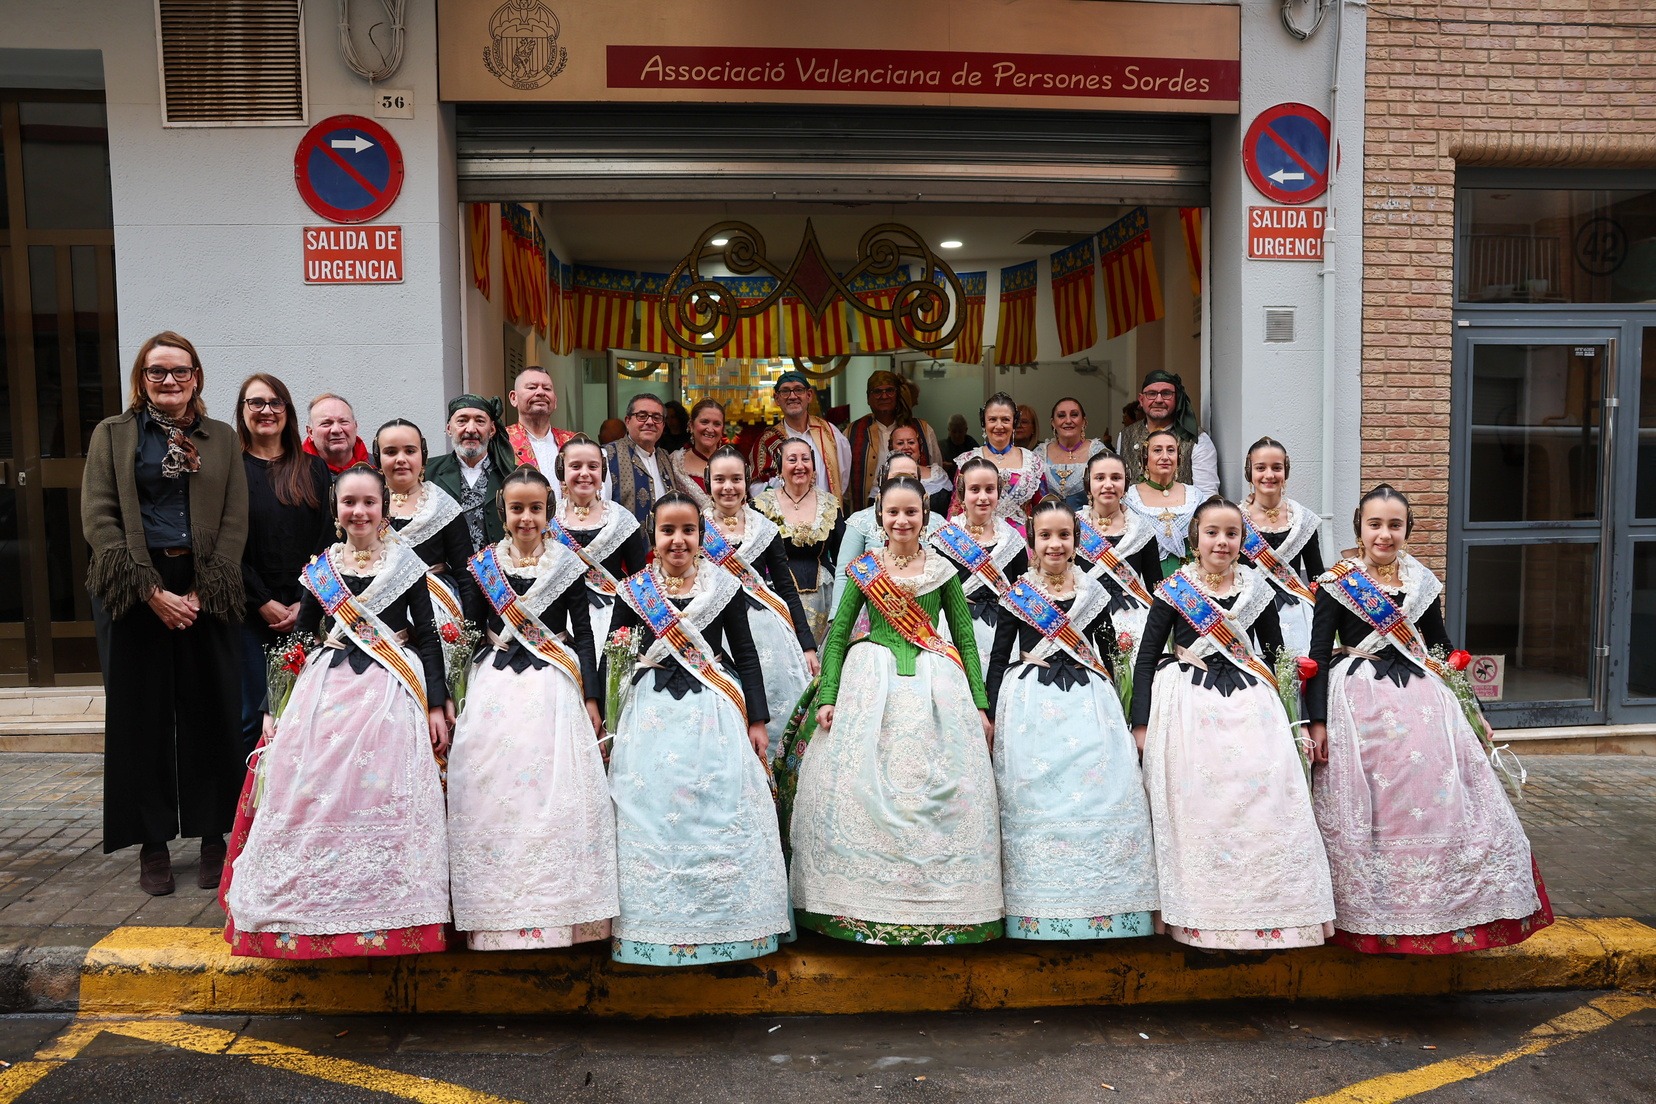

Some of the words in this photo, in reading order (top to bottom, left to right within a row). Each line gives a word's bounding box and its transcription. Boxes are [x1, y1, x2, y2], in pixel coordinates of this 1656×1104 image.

[640, 54, 785, 82] Associació
[796, 57, 940, 85] Valenciana
[952, 62, 982, 86] de
[993, 61, 1112, 90] Persones
[1122, 65, 1210, 93] Sordes
[512, 81, 539, 89] SORDOS
[382, 95, 405, 109] 36
[1252, 210, 1307, 229] SALIDA
[306, 230, 369, 250] SALIDA
[375, 230, 397, 250] DE
[1253, 237, 1323, 256] URGENCI
[1583, 231, 1618, 262] 42
[308, 260, 397, 279] URGENCIA
